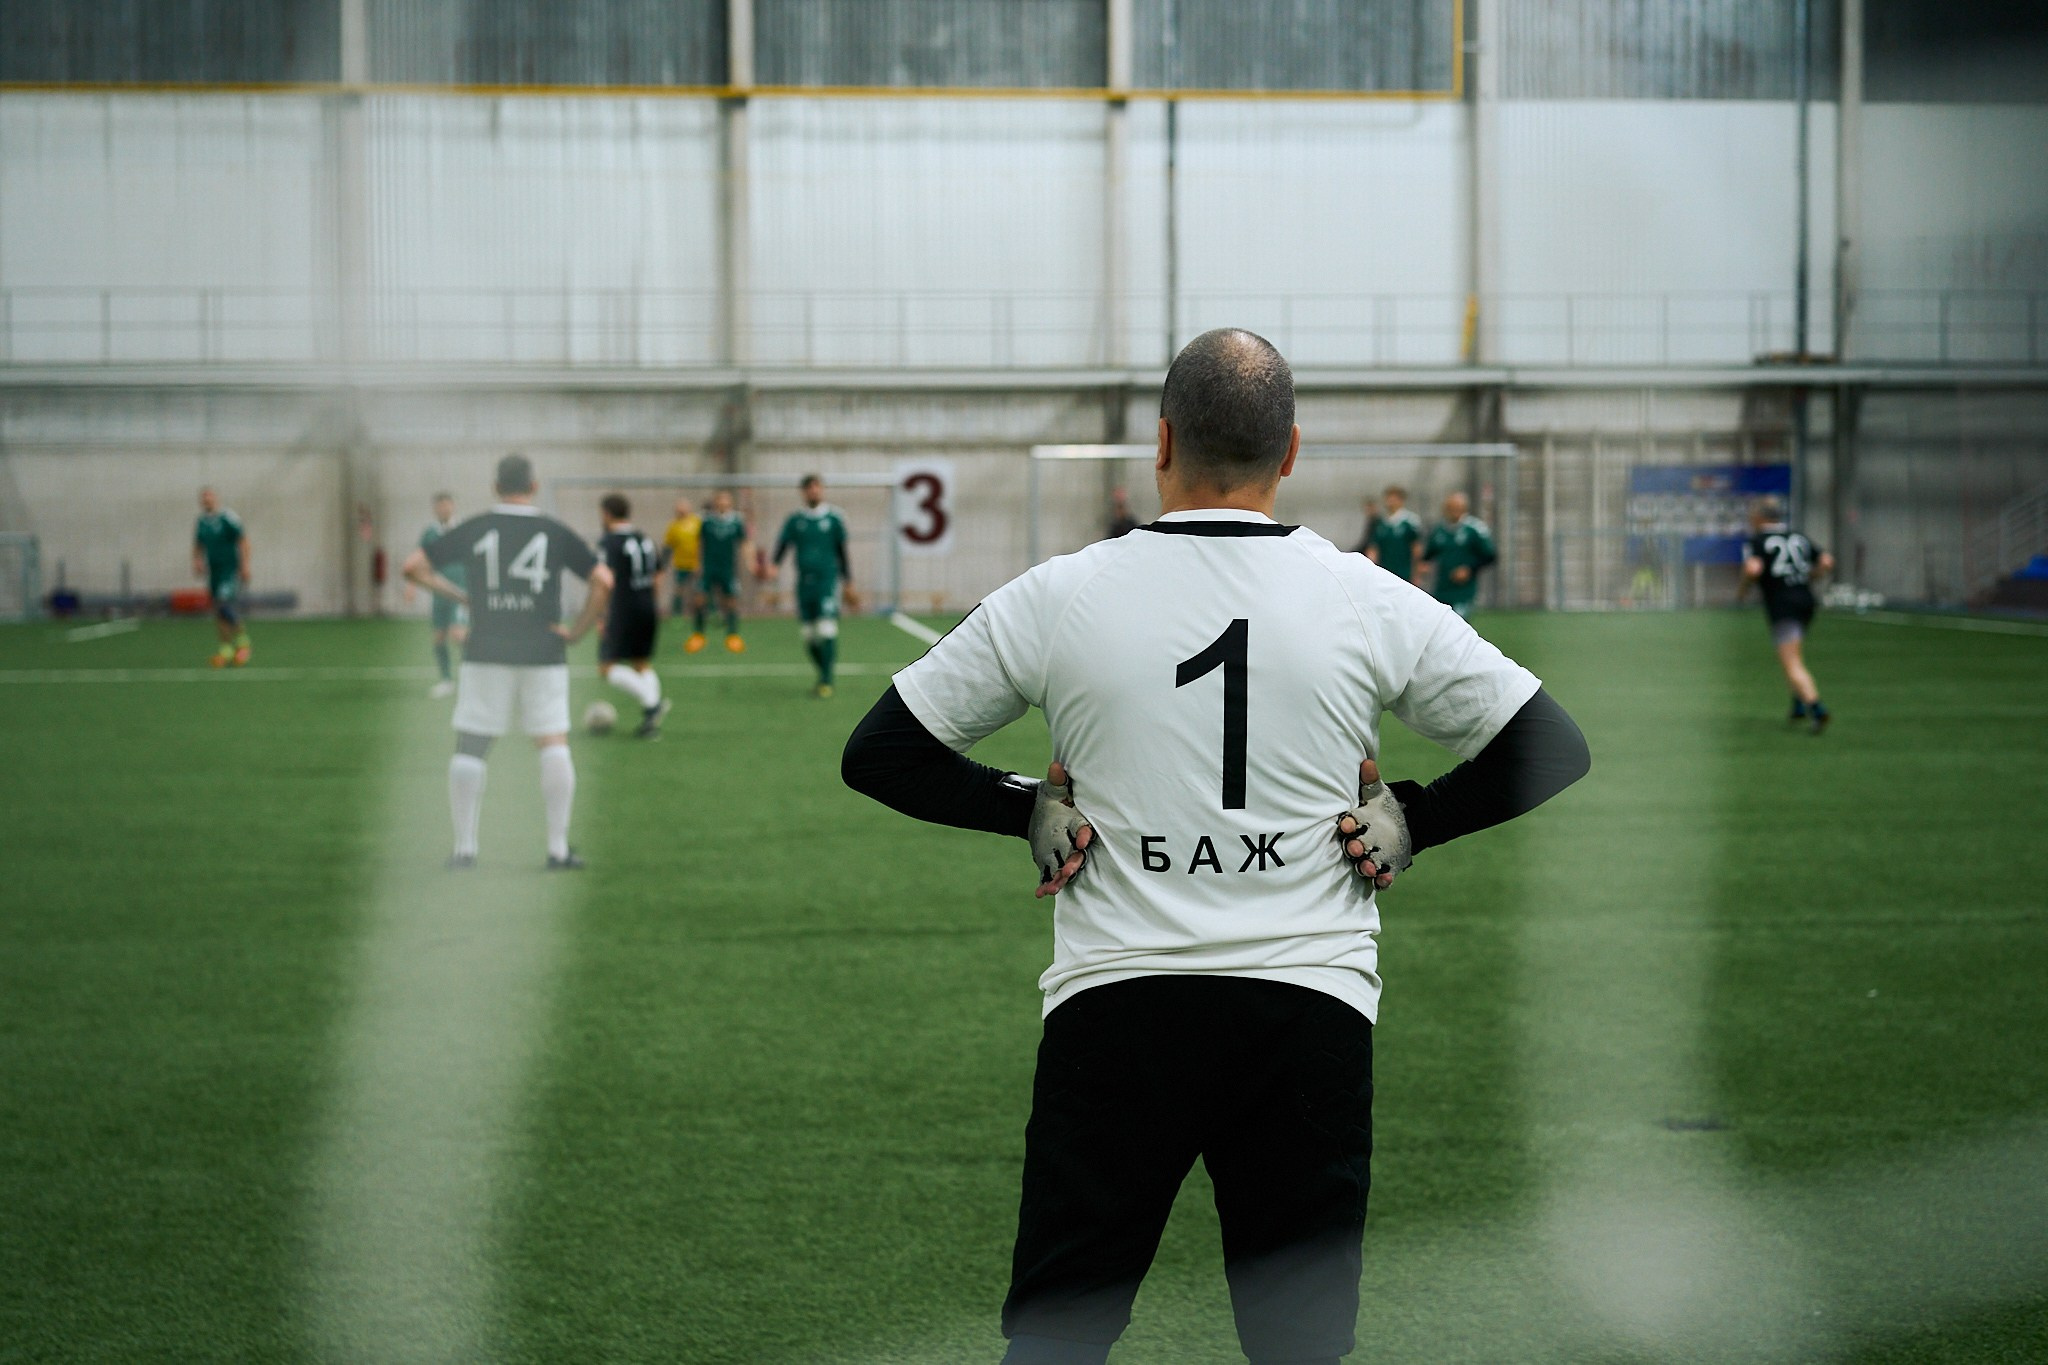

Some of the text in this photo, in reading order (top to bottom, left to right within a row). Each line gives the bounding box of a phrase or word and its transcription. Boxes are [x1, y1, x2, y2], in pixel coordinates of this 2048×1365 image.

[901, 473, 949, 545] 3
[473, 529, 550, 594] 14
[1764, 533, 1811, 577] 20
[1175, 618, 1249, 810] 1
[1140, 832, 1286, 875] БАЖ
